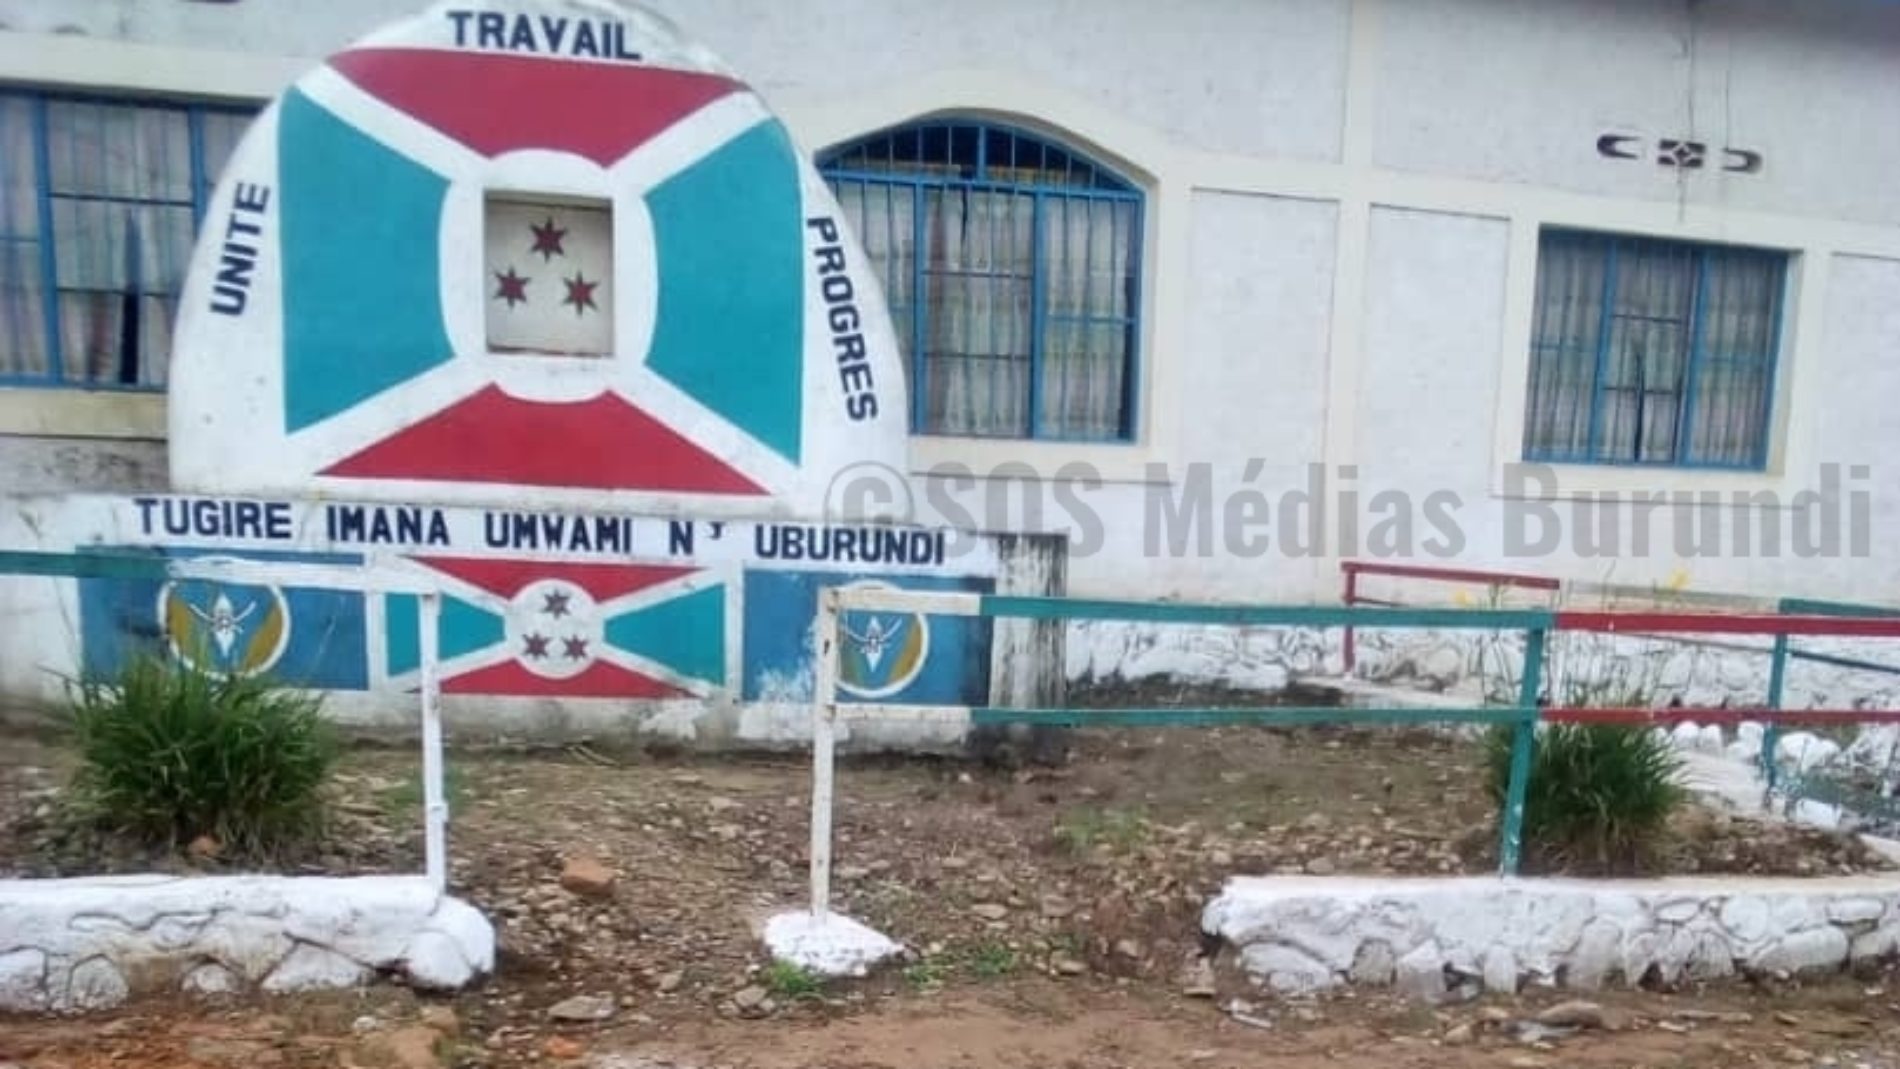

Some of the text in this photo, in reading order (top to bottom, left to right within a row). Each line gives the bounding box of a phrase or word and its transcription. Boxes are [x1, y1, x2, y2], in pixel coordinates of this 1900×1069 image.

[447, 10, 642, 61] TRAVAIL
[210, 182, 270, 316] UNITE
[807, 217, 877, 421] PROGRES
[135, 498, 292, 539] TUGIRE
[328, 506, 450, 546] IMANA
[485, 513, 632, 555] UMWAMI
[756, 523, 945, 564] UBURUNDI
